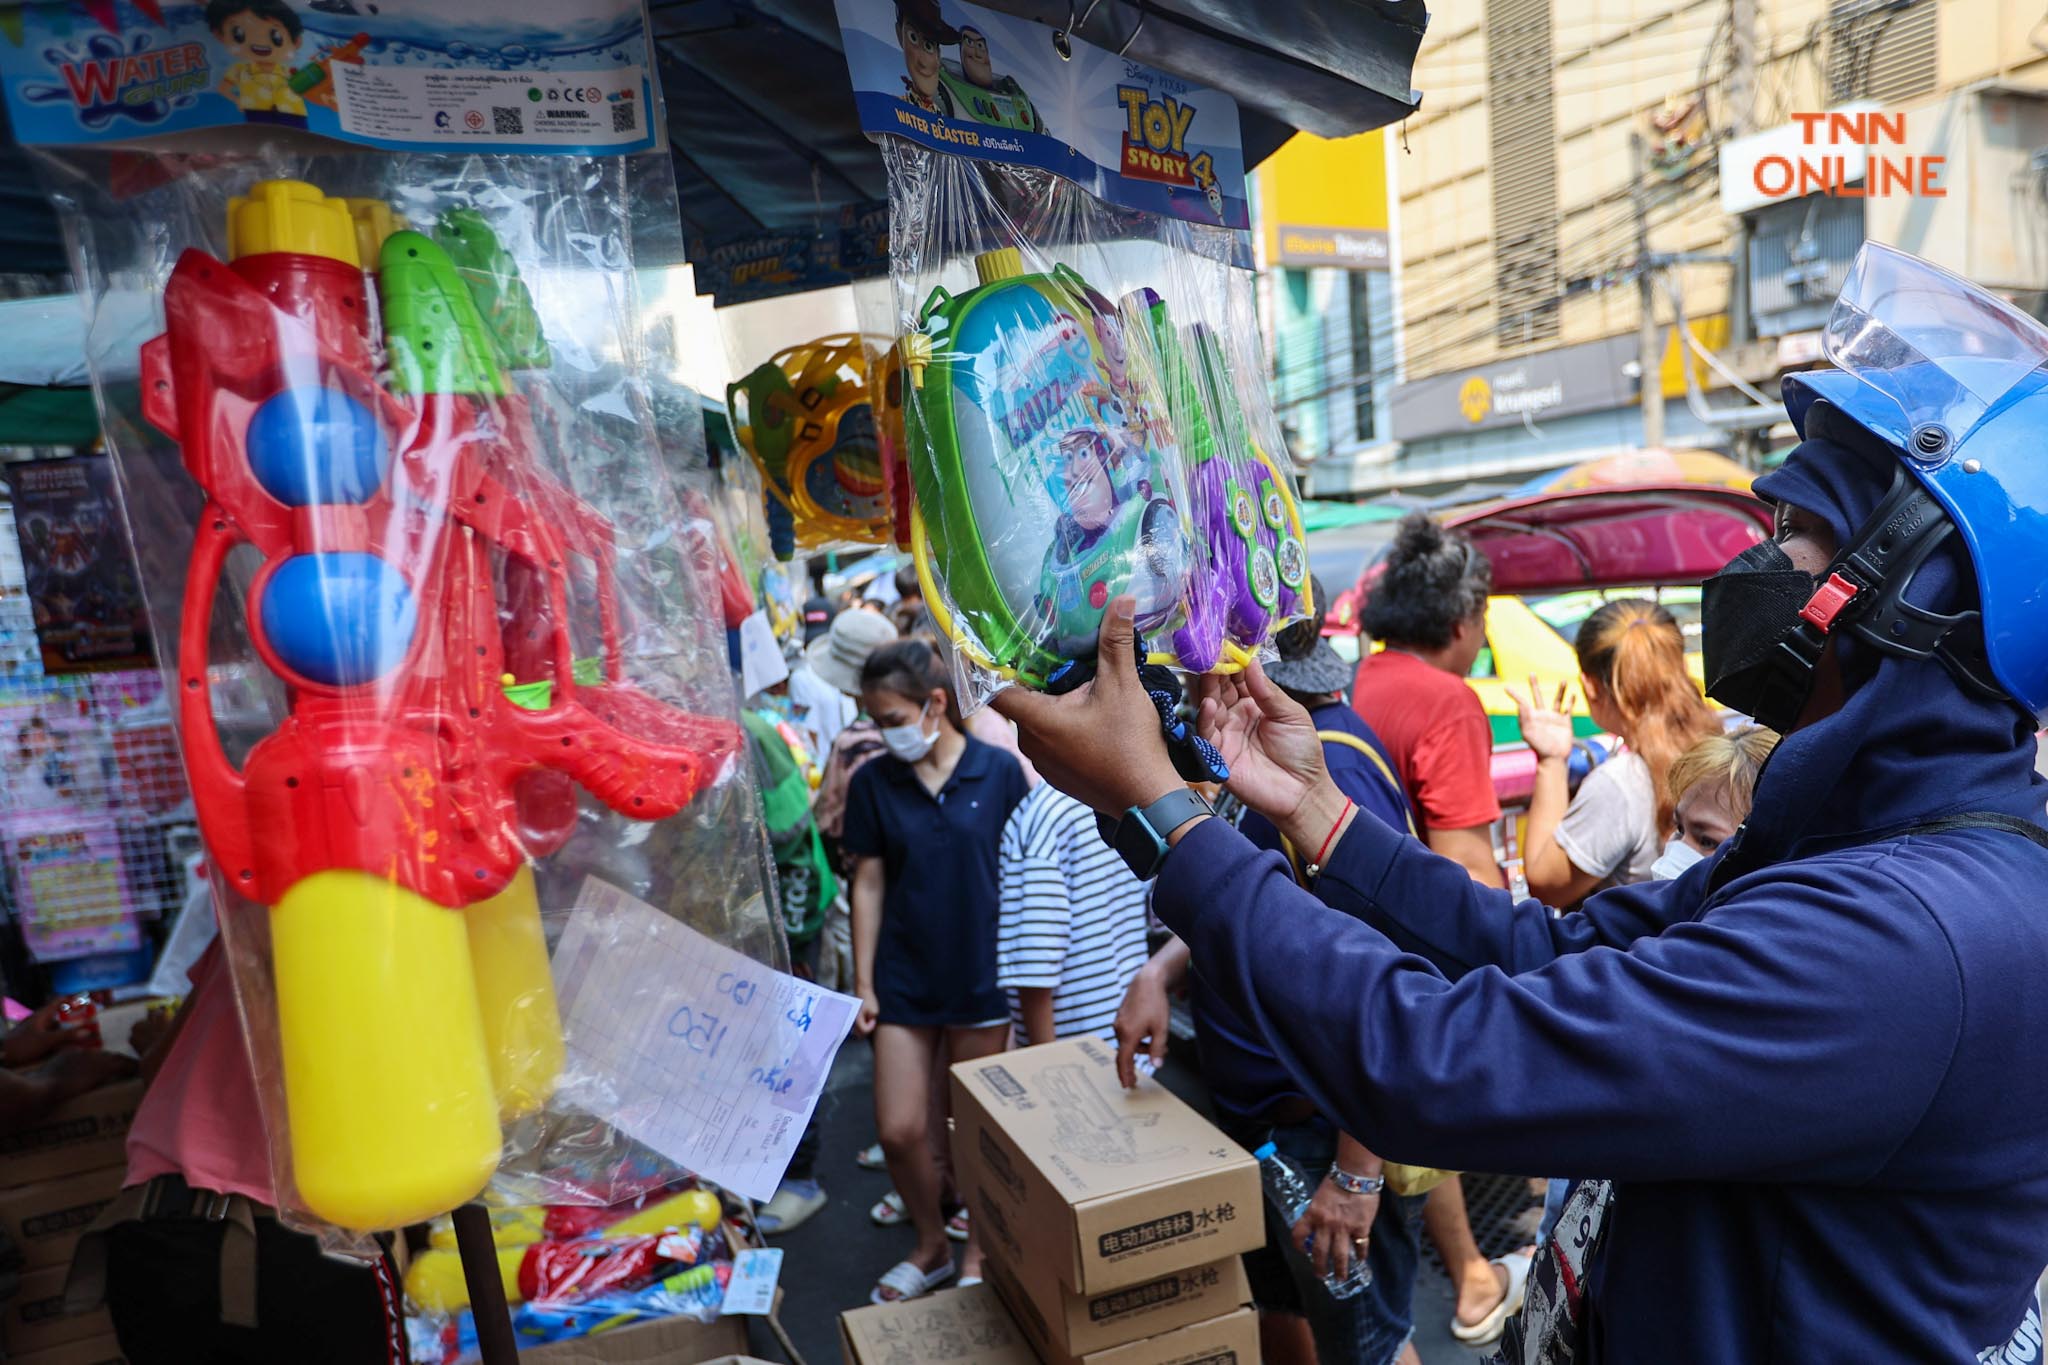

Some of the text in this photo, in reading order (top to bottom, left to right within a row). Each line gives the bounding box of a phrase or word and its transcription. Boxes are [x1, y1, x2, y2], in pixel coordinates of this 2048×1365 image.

[61, 43, 205, 108] WATER
[123, 71, 208, 106] GUN
[895, 107, 981, 147] WATER BLASTER
[1117, 84, 1197, 156] TOY
[1127, 147, 1215, 190] STORY 4
[999, 377, 1068, 450] BUZZ
[1886, 497, 1921, 537] PRETTY
[1901, 511, 1925, 539] LADY
[1102, 1202, 1236, 1253] 电动加特林 水枪
